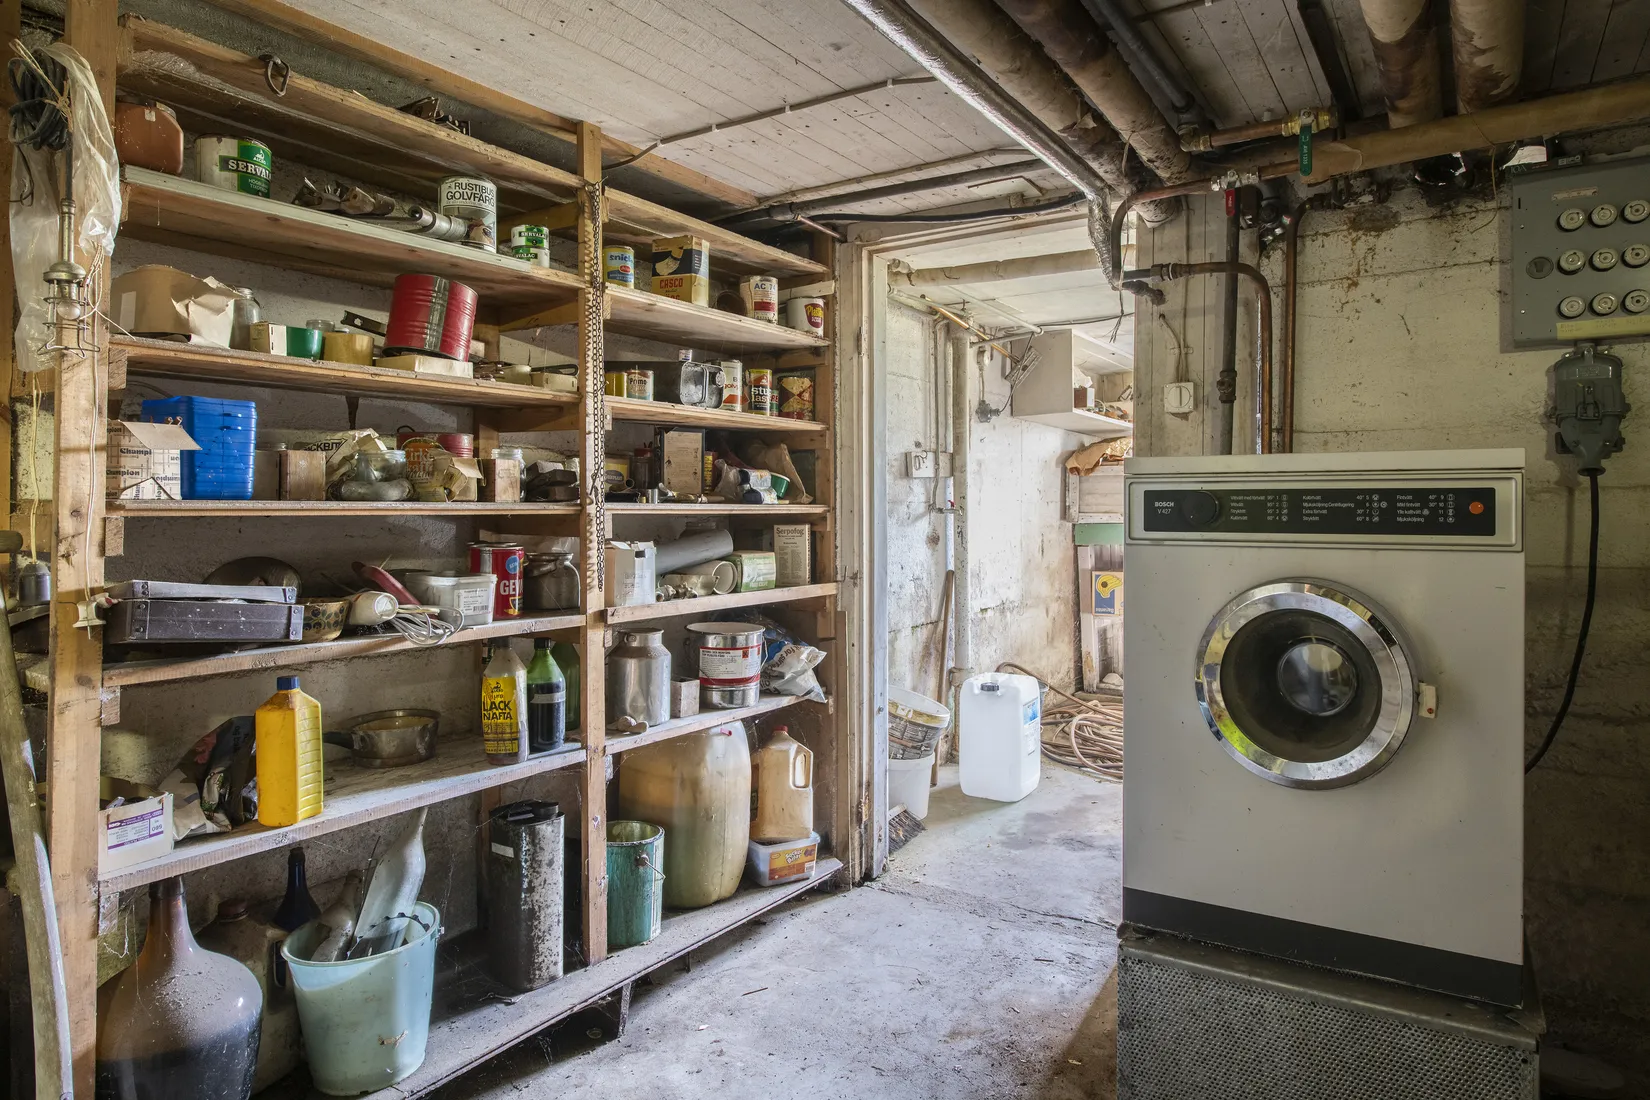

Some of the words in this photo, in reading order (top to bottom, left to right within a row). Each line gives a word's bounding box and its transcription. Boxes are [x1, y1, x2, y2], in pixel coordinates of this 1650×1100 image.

[454, 182, 495, 198] RUSTIBUS
[659, 277, 684, 289] CASCO
[776, 527, 804, 535] Serpofog
[482, 701, 512, 711] LACK
[483, 711, 513, 721] NAFTA
